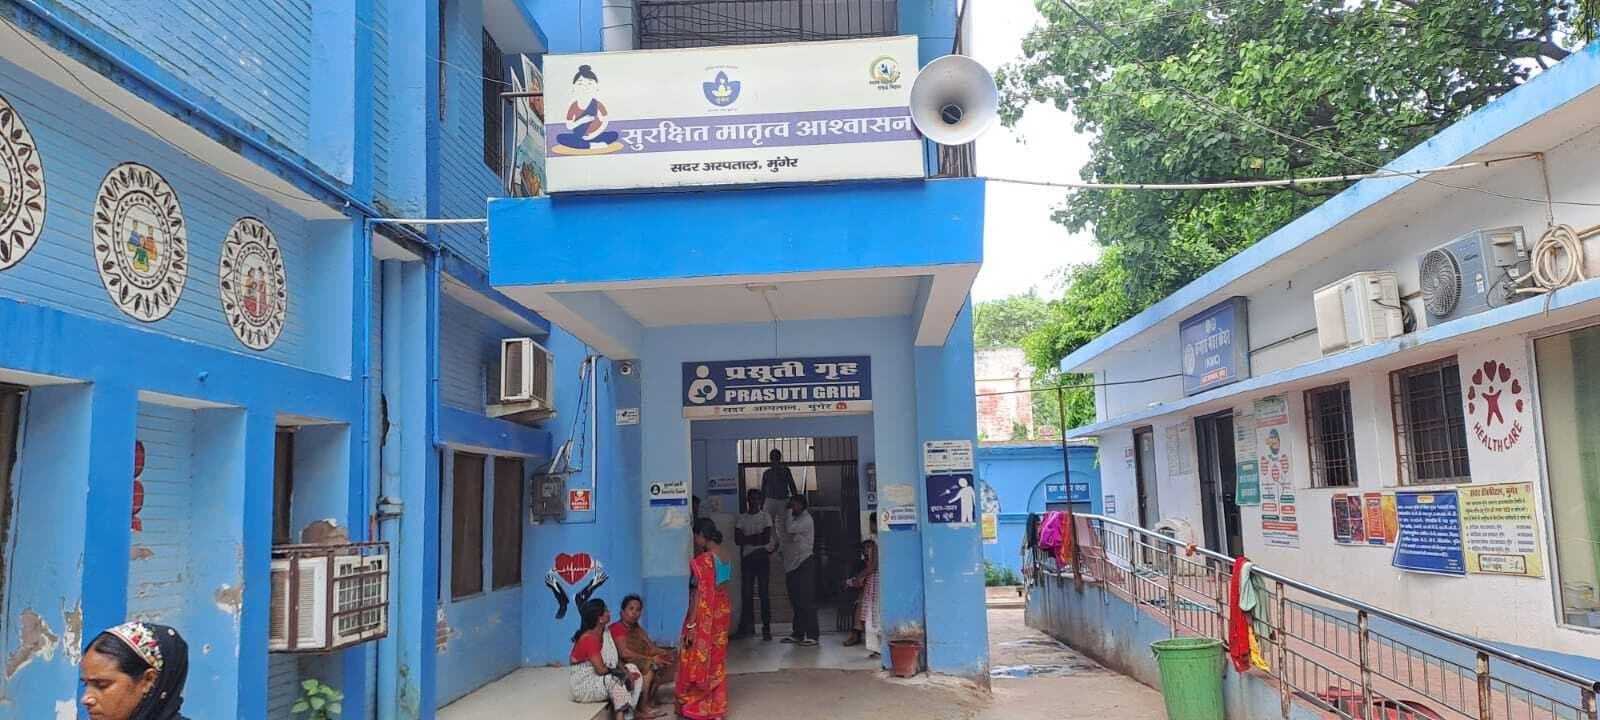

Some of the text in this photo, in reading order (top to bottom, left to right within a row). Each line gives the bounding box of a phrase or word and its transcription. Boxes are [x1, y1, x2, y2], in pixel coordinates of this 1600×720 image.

[621, 116, 912, 150] सुरक्षित मातृत्व आश्वासन
[670, 161, 699, 173] सदर
[767, 155, 798, 173] मुंगेर
[725, 362, 858, 382] प्रसूती गृह
[725, 385, 860, 402] PRASUTI GRIH
